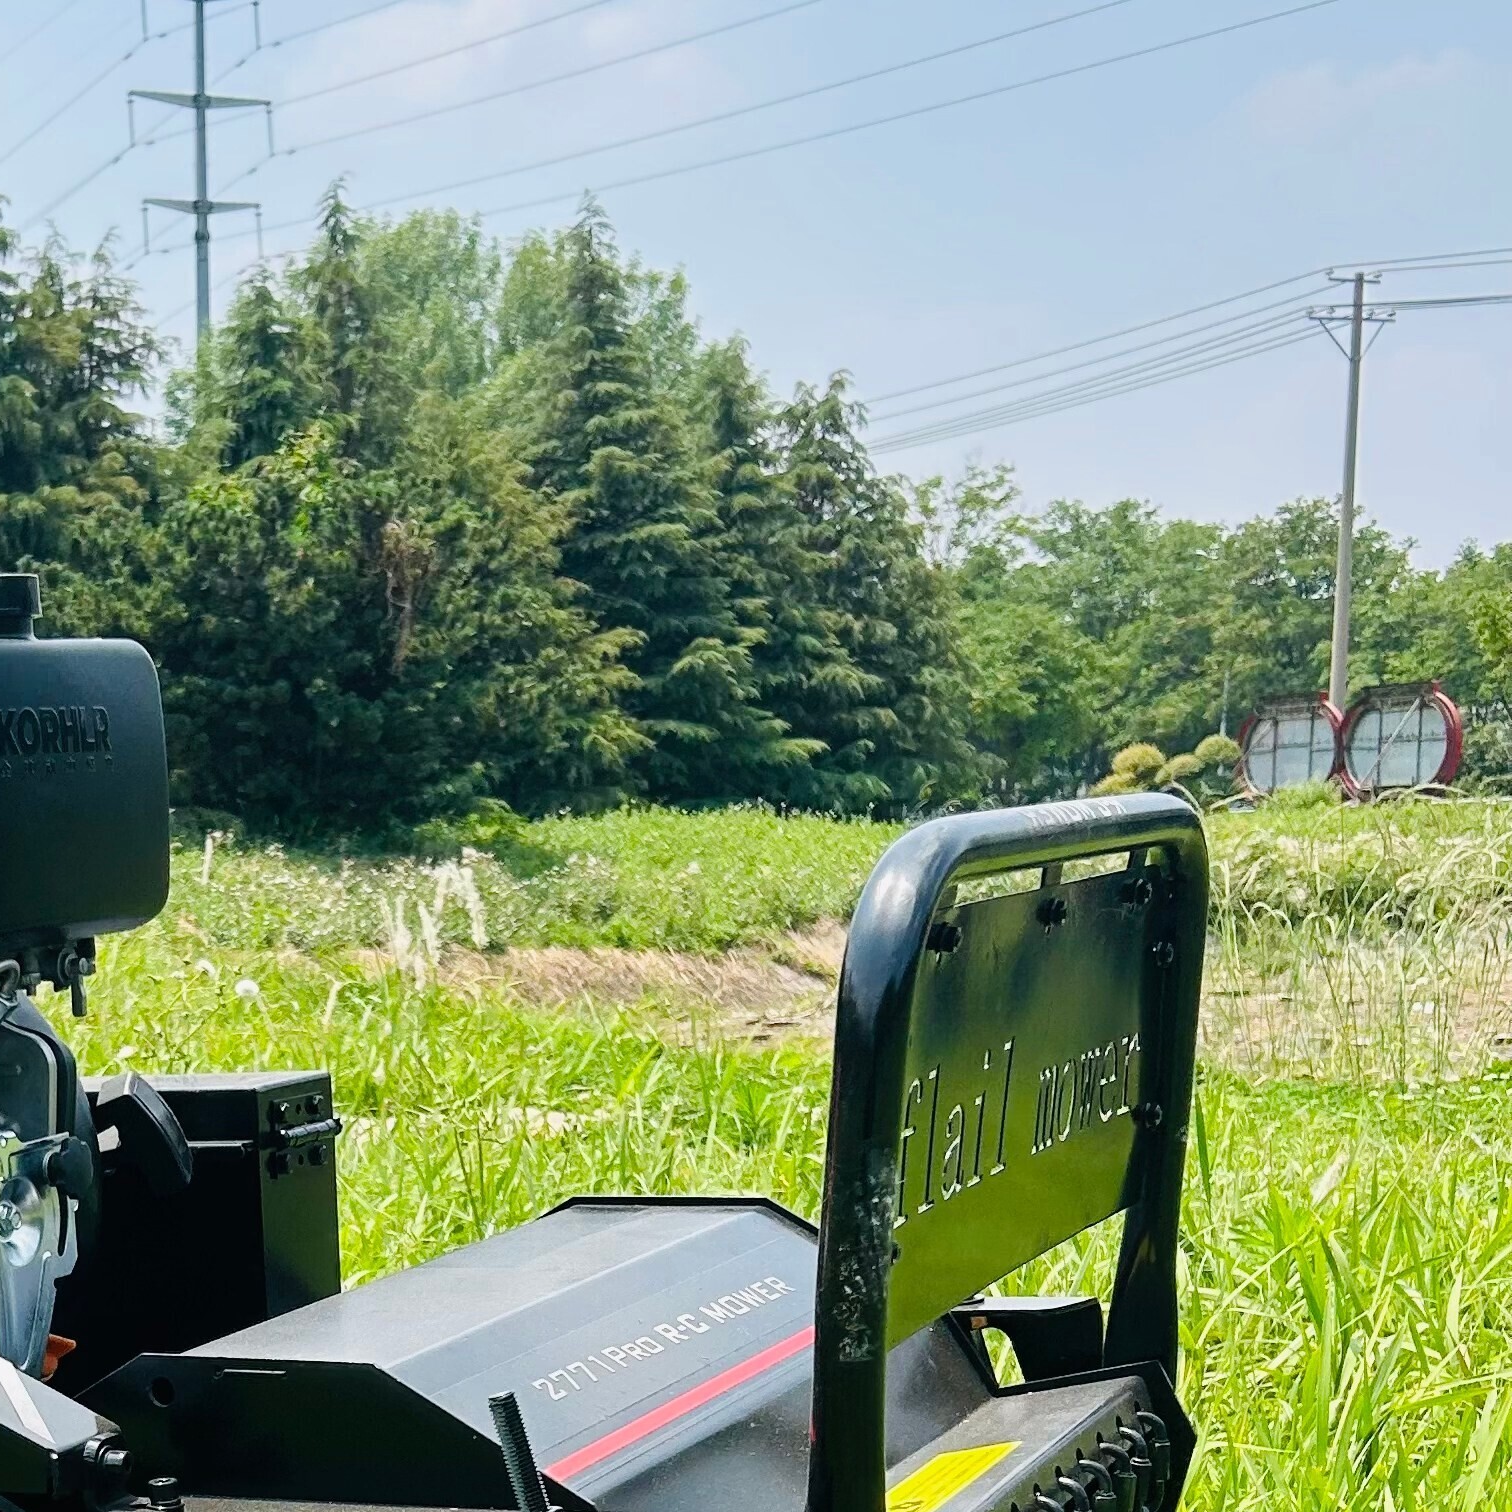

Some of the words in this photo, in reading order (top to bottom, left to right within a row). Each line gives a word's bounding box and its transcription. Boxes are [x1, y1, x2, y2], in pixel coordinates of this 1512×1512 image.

[893, 1036, 1016, 1229] flail
[653, 1313, 711, 1345] R-C
[698, 1276, 797, 1324] MOWER
